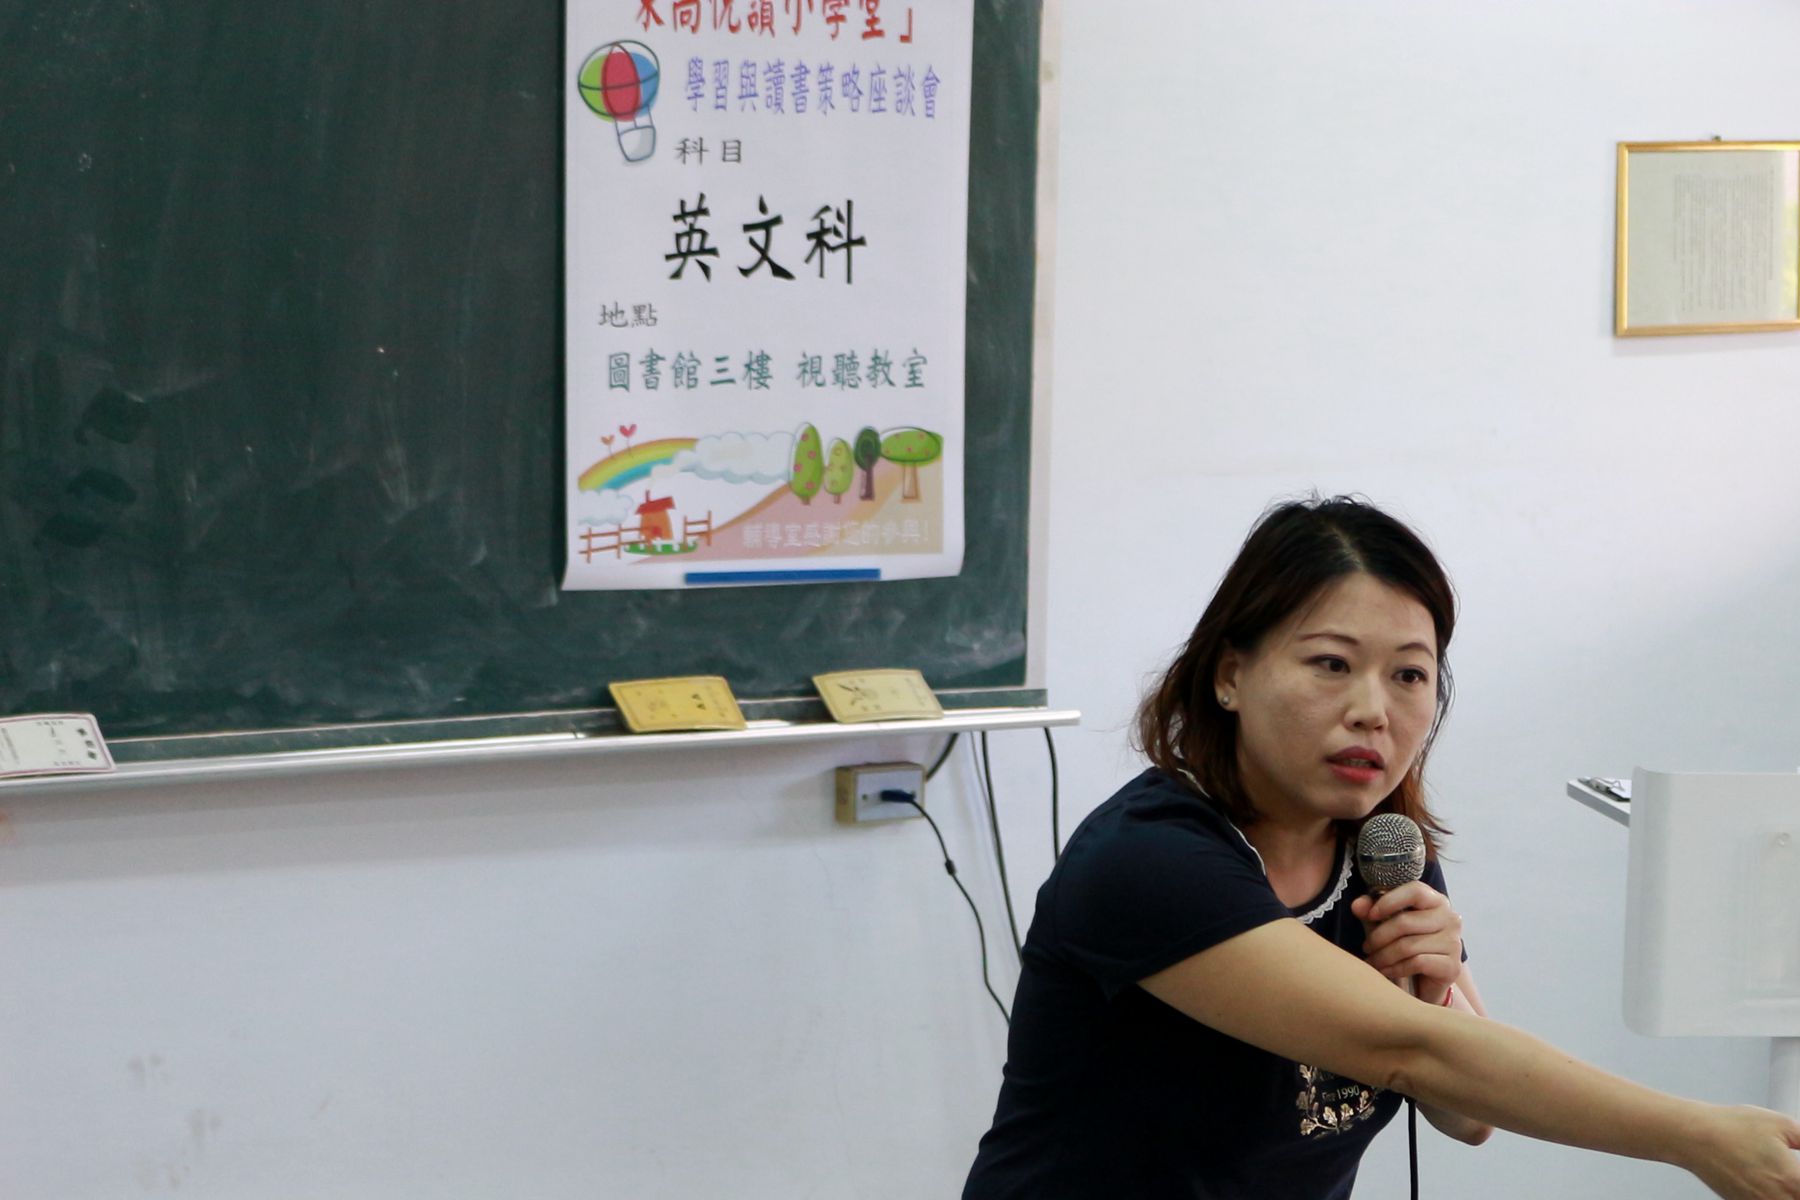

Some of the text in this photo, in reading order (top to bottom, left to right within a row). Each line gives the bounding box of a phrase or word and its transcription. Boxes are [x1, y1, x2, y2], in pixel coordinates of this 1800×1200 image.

[685, 55, 941, 119] 學習與讀書策略座談會
[674, 136, 743, 165] 科目
[664, 193, 867, 285] 英文科
[597, 301, 659, 329] 地點
[607, 347, 929, 392] 圖書館三樓 視聽教室
